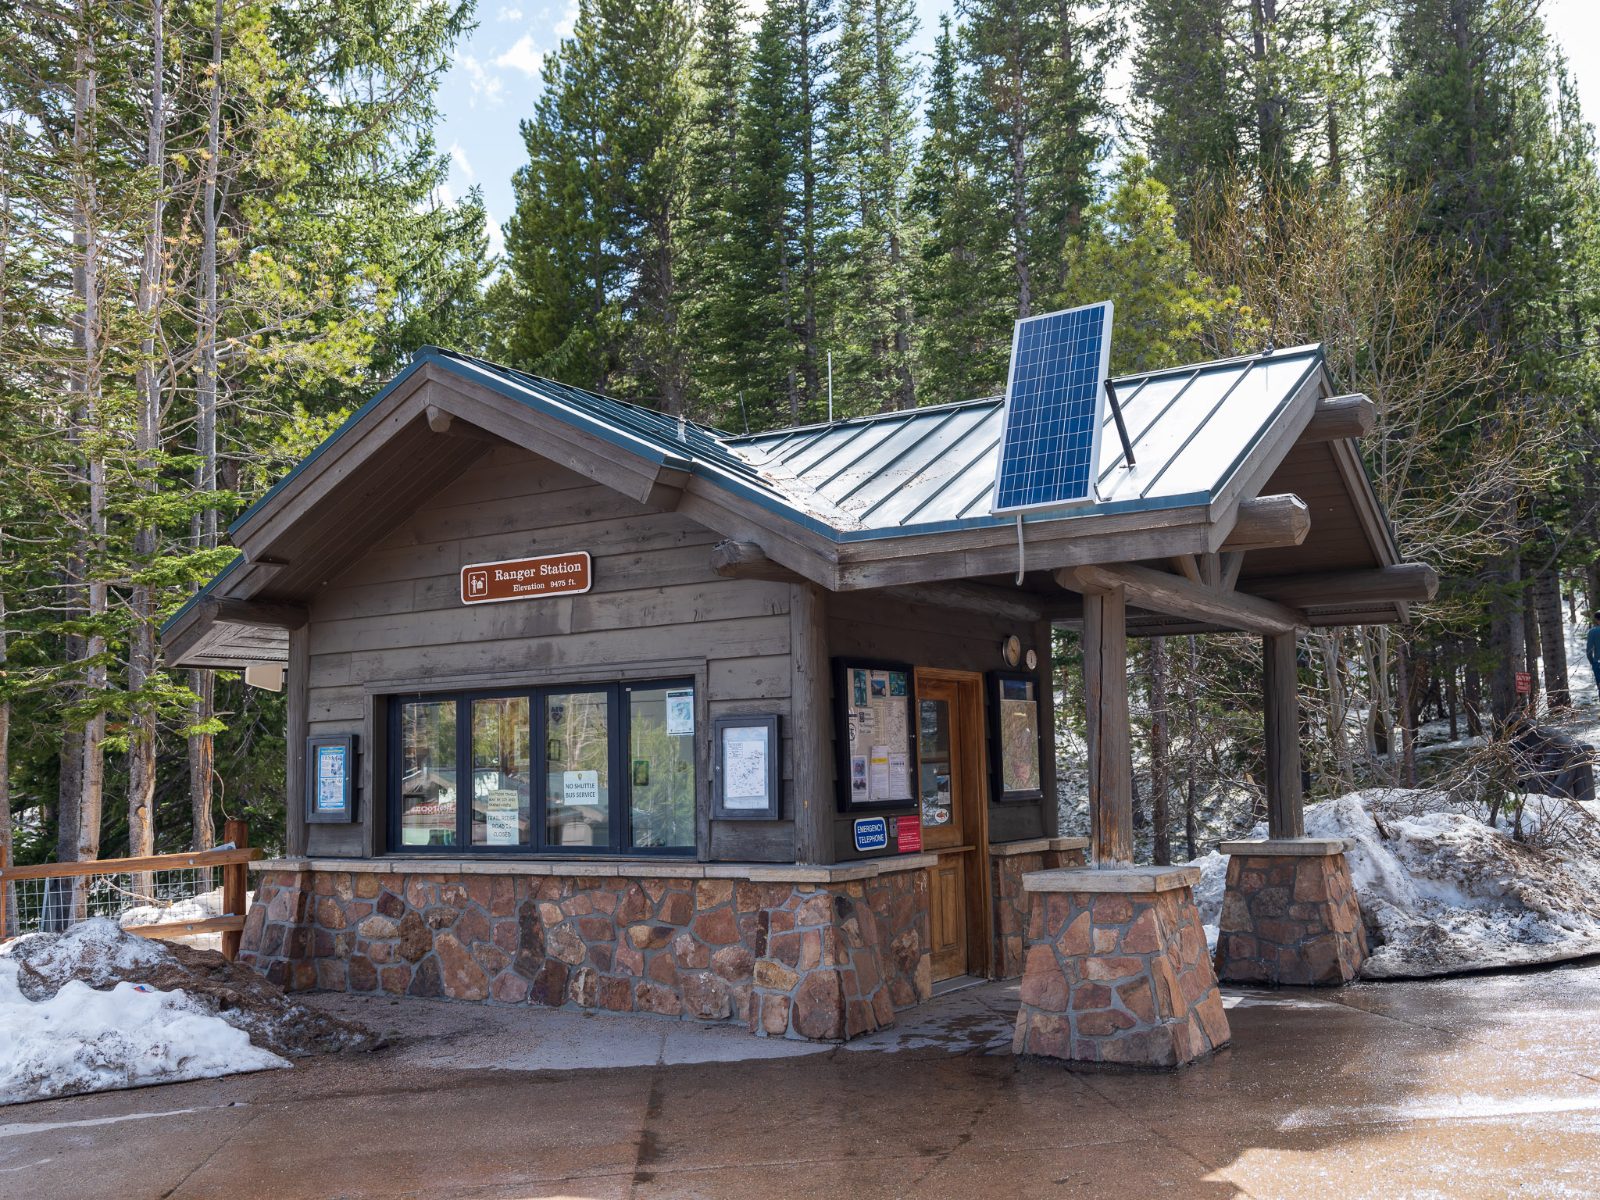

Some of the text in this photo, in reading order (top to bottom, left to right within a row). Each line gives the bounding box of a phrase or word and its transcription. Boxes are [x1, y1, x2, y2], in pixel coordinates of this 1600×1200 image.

[495, 562, 581, 581] Ranger Station
[513, 578, 576, 592] Elevation 9475 ft.
[857, 823, 883, 834] EMERGENCY
[858, 834, 885, 845] TELEPHONE
